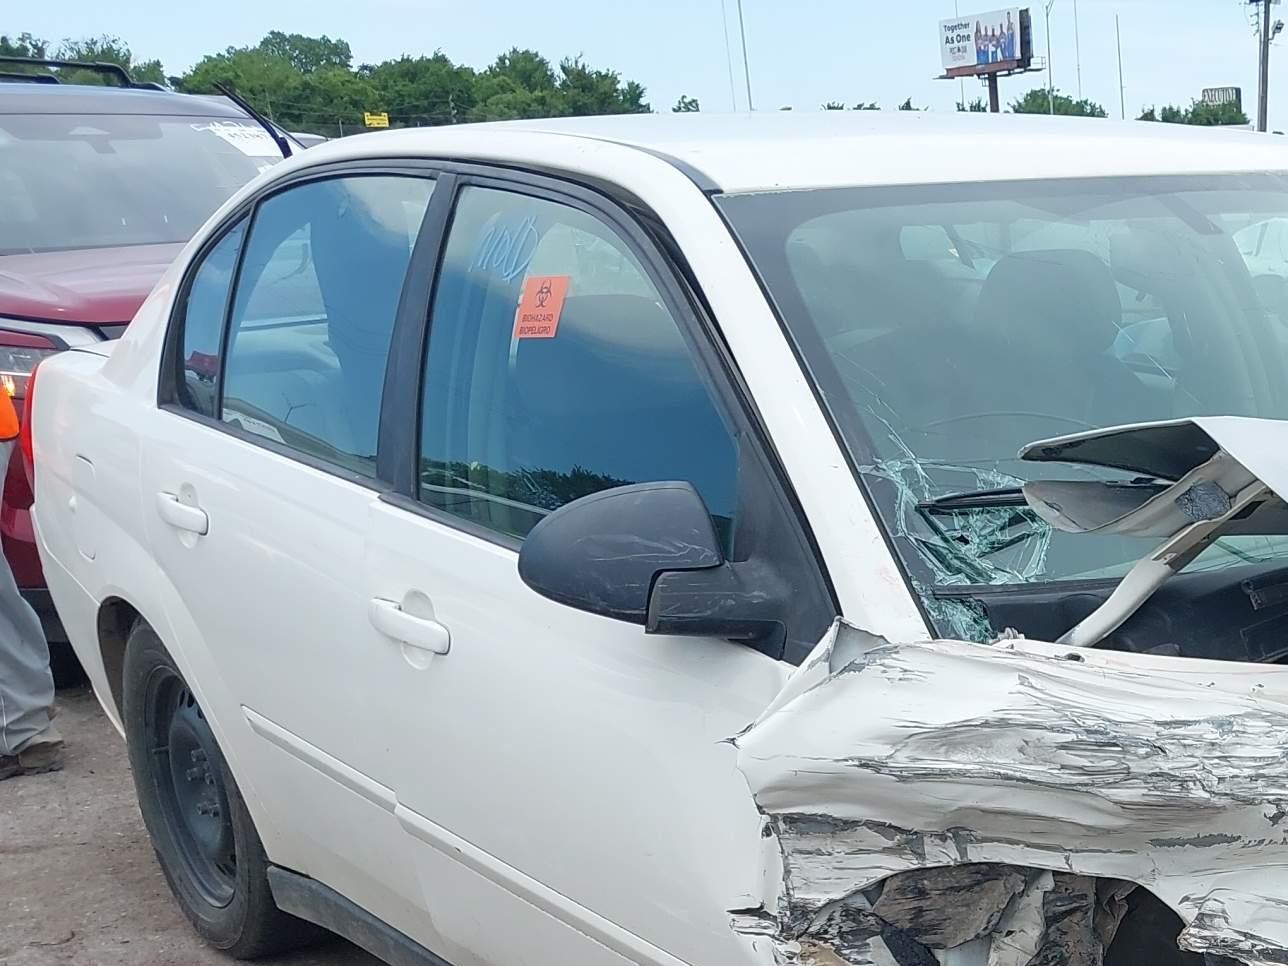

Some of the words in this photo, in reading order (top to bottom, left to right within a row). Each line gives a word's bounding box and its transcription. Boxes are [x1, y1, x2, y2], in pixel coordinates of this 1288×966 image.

[944, 22, 970, 34] Together
[945, 35, 955, 45] As
[955, 33, 971, 44] One
[522, 313, 554, 323] BIOHAZARD
